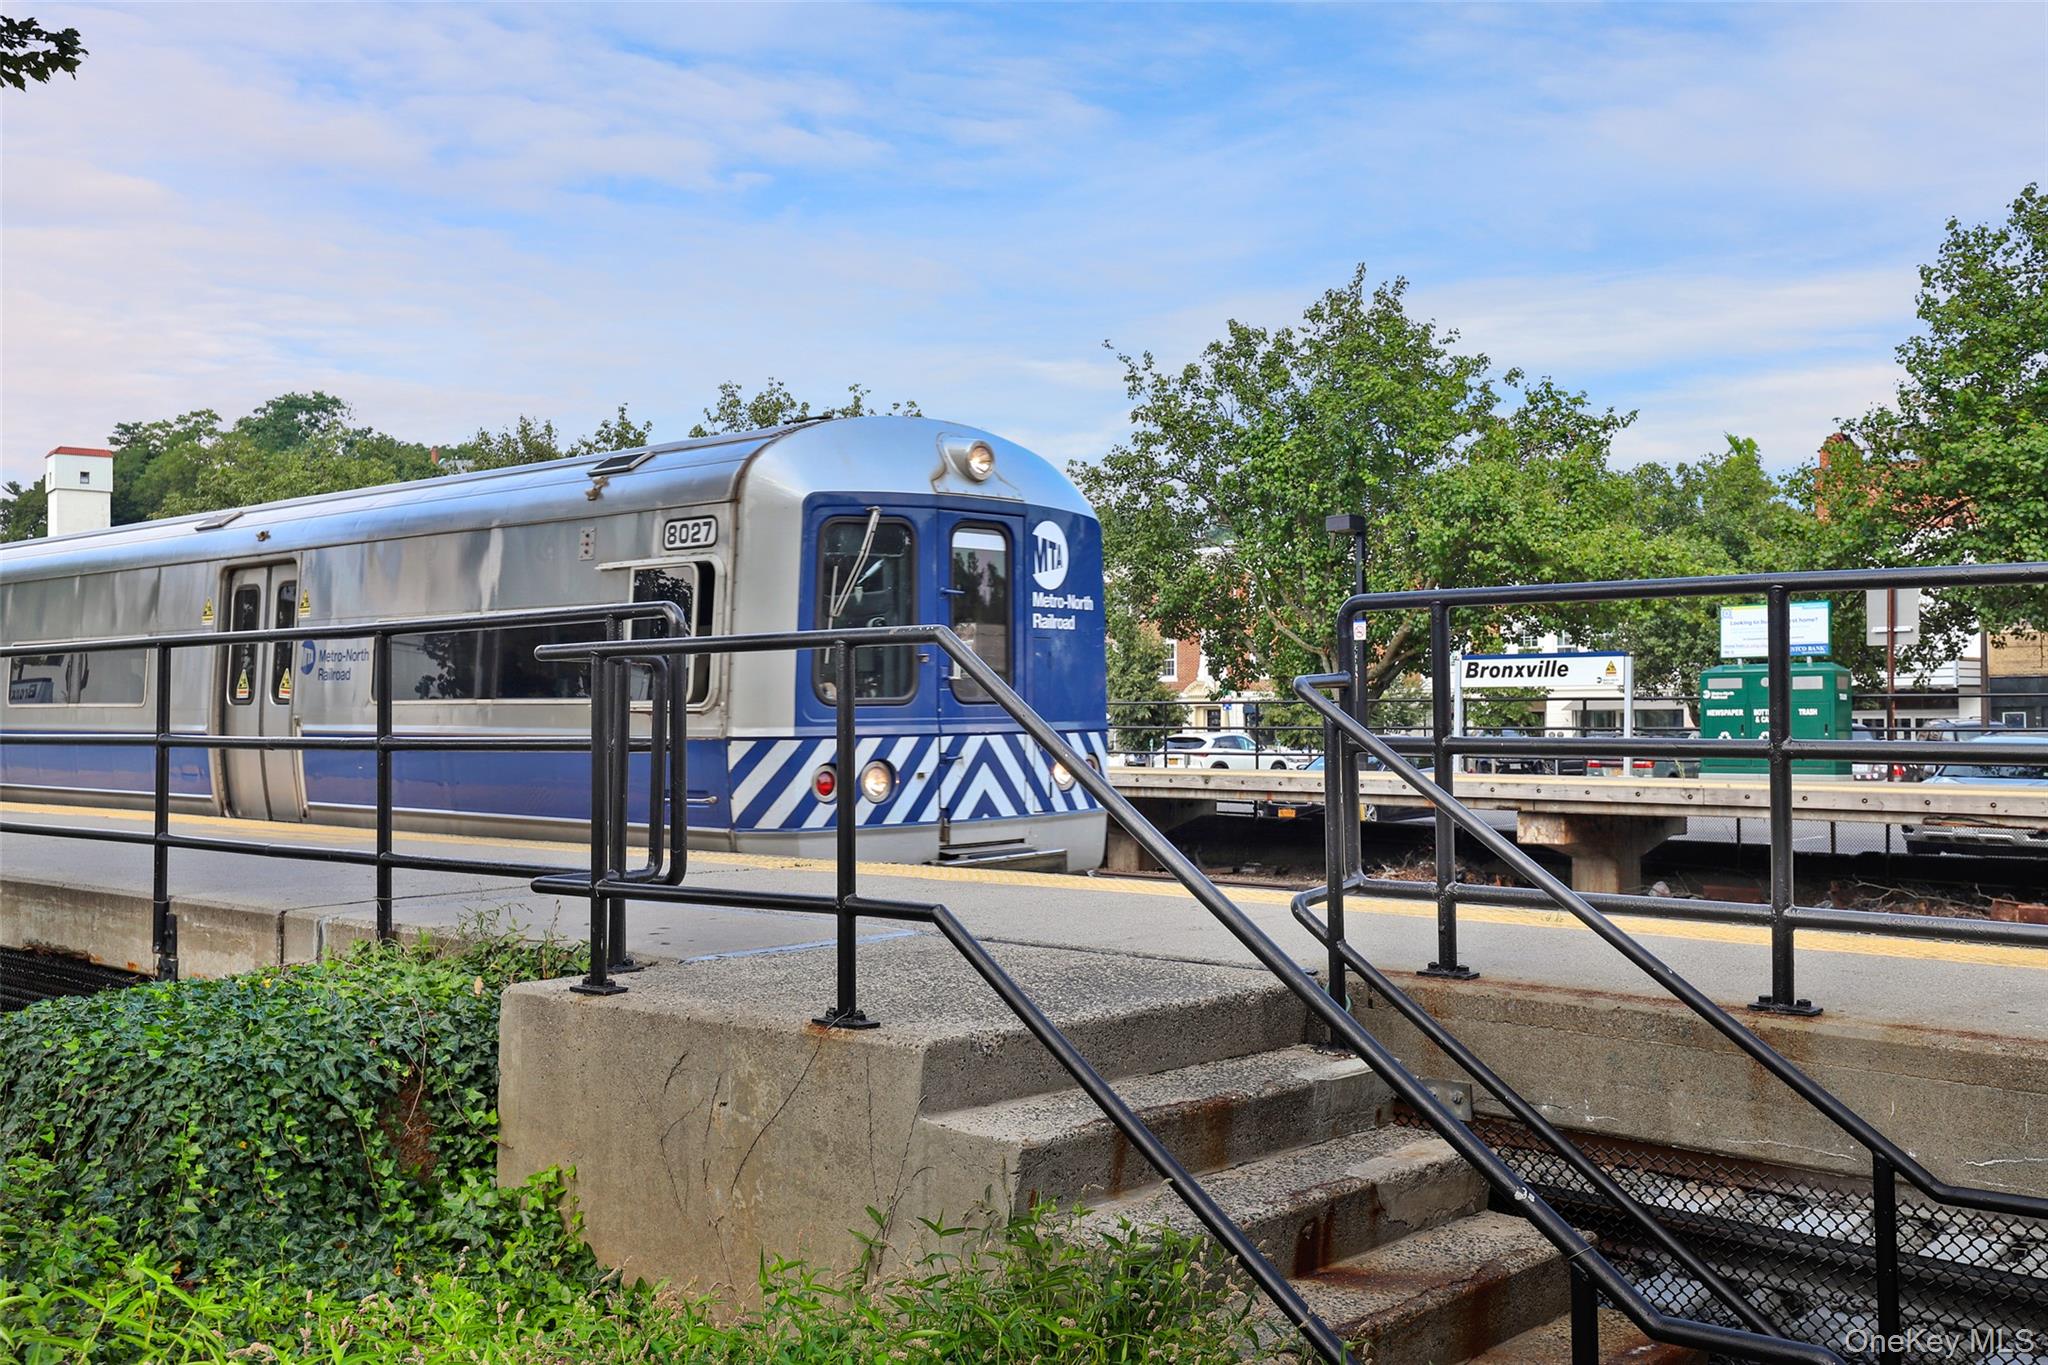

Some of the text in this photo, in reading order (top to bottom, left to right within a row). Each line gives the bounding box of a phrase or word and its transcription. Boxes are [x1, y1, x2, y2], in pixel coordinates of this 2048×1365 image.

[667, 521, 712, 545] 8027
[1033, 535, 1063, 574] MTA
[1032, 591, 1094, 611] Metro-North
[1032, 613, 1076, 630] Railroad
[319, 648, 370, 662] Metro-North
[317, 667, 352, 681] Railroad
[1465, 660, 1569, 679] Bronxville
[1798, 708, 1818, 716] TRASH
